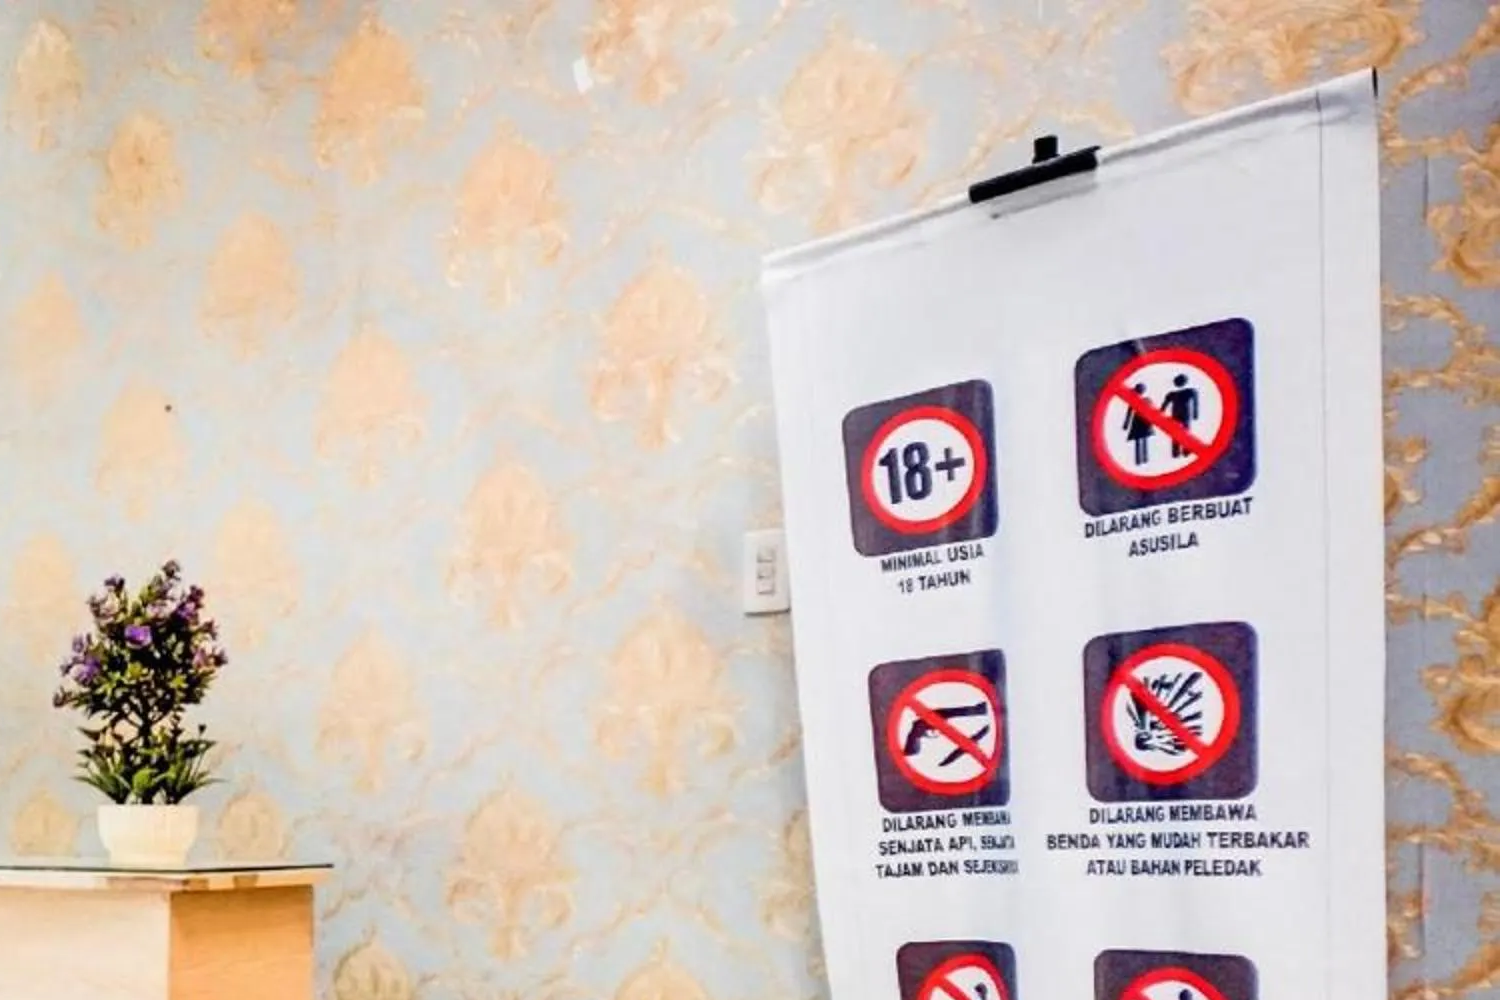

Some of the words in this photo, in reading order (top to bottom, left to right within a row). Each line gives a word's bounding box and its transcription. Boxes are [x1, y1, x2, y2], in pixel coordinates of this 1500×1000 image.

[878, 441, 966, 505] 18+
[1084, 509, 1162, 538] DILARANG
[1167, 497, 1254, 525] BERBUAT
[1128, 531, 1200, 558] ASUSILA
[880, 549, 942, 573] MINIMAL
[946, 543, 985, 563] USIA
[897, 576, 915, 594] 18
[918, 569, 972, 592] TAHUN
[882, 813, 958, 833] DILARANG
[1089, 806, 1165, 825] DILARANG
[1169, 804, 1258, 822] MEMBAWA
[878, 836, 945, 857] SENJATA
[1046, 833, 1101, 850] BENDA
[1106, 833, 1147, 850] YANG
[1151, 832, 1201, 849] MUDAH
[1206, 831, 1311, 849] TERBAKAR
[875, 860, 923, 878] TAJAM
[927, 859, 959, 877] DAN
[1086, 859, 1127, 876] ATAU
[1130, 859, 1181, 876] BAHAN
[1184, 859, 1263, 877] PELEDAK
